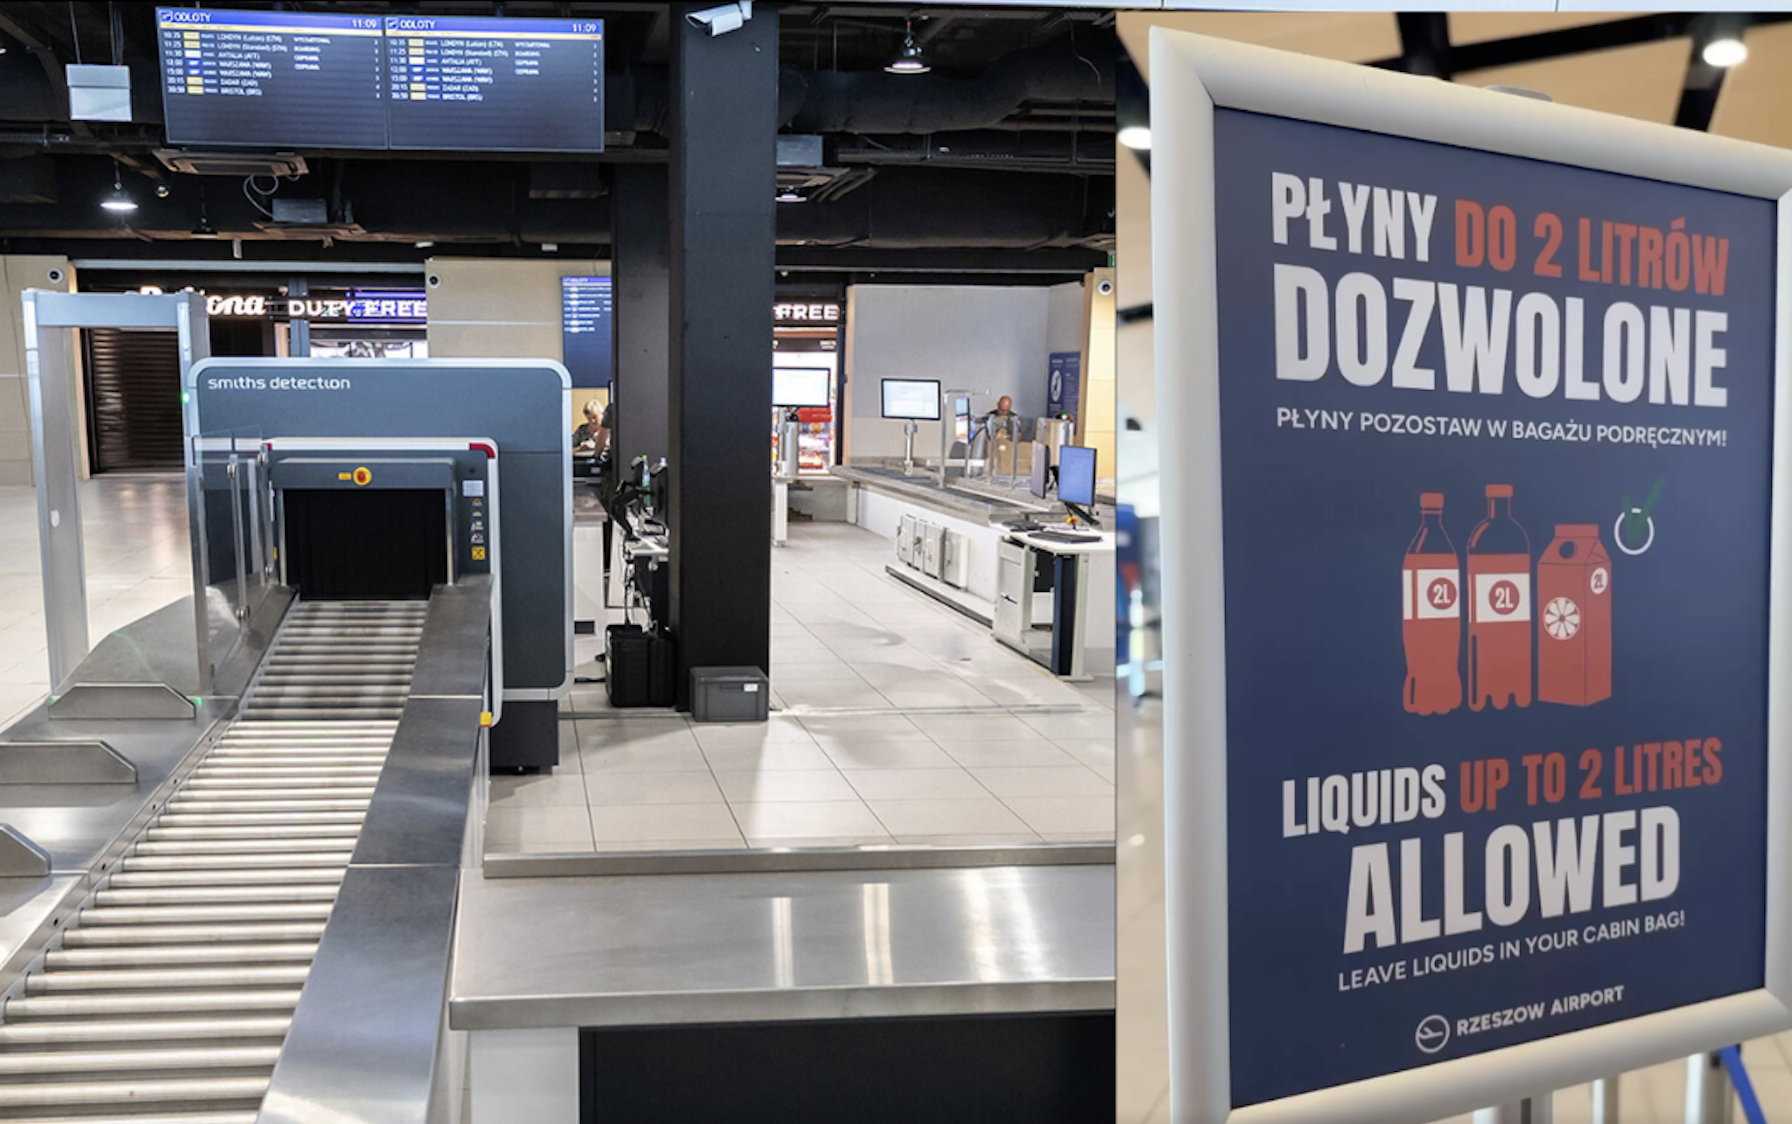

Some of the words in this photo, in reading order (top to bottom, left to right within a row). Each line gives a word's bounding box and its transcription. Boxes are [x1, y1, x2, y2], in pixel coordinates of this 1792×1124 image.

[174, 12, 211, 22] ODLOTY
[352, 19, 377, 28] 11:09
[400, 19, 435, 30] ODLOTY
[572, 23, 597, 32] 11:09
[1272, 172, 1437, 262] PŁYNY
[1455, 199, 1516, 272] DO
[1534, 211, 1563, 278] 2
[1578, 217, 1729, 295] LITRÓW
[288, 299, 356, 317] DUTY
[364, 300, 427, 317] FREE
[774, 304, 839, 320] FREE
[1274, 263, 1728, 407] DOZWOLONE
[208, 377, 266, 390] smiths
[270, 377, 350, 390] detection
[1277, 408, 1354, 431] PŁYNY
[1360, 413, 1482, 437] POZOSTAW
[1486, 419, 1508, 438] W
[1512, 418, 1592, 442] BAGAŻU
[1597, 425, 1727, 449] PODRĘCZNYM!
[1593, 573, 1604, 590] 2L
[1433, 584, 1451, 604] 2L
[1495, 587, 1514, 609] 2L
[1283, 764, 1446, 838] LIQUIDS
[1460, 758, 1510, 814] UP
[1522, 752, 1566, 805] TO
[1578, 749, 1602, 799] 2
[1614, 737, 1722, 796] LITRES
[1343, 806, 1680, 954] ALLOWED
[1339, 961, 1406, 991] LEAVE
[1413, 944, 1494, 976] LIQUIDS
[1500, 941, 1520, 959] IN
[1526, 930, 1578, 954] YOUR
[1583, 919, 1639, 943] CABIN
[1645, 910, 1685, 932] BAG!
[1457, 1003, 1545, 1037] RZESZOW
[1550, 985, 1624, 1016] AIRPORT
